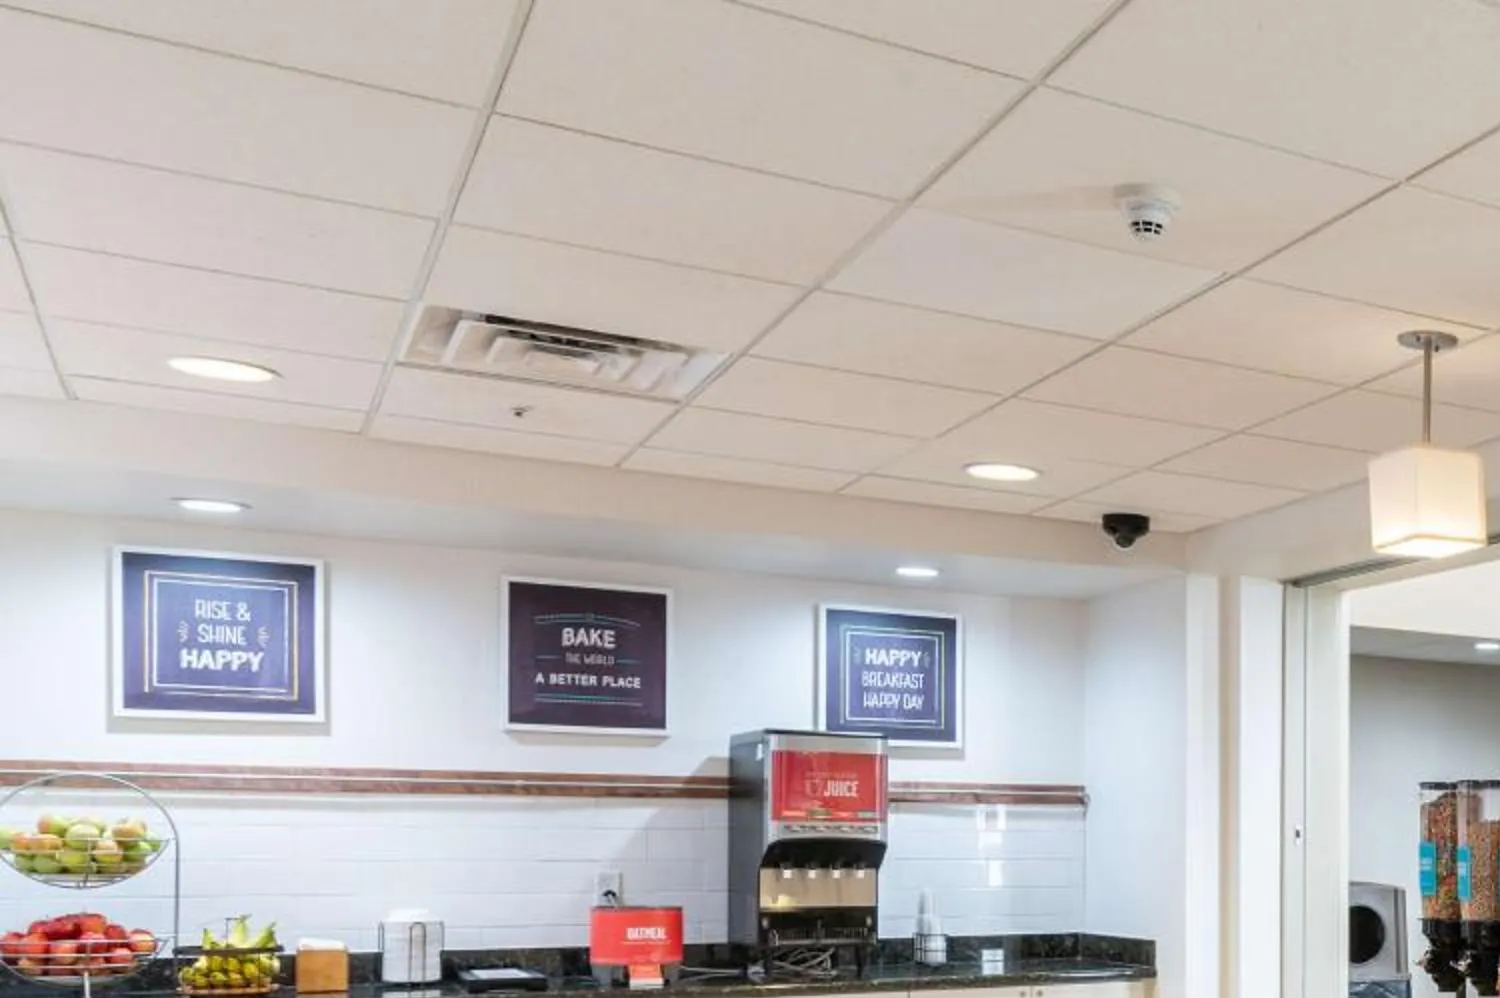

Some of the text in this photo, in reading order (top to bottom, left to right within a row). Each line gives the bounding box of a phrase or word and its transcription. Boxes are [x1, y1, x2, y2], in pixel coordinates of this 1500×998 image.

[195, 599, 251, 621] RISE &
[197, 624, 247, 646] SHINE
[561, 627, 616, 649] BAKE
[179, 648, 264, 673] HAPPY
[864, 648, 922, 668] HAPPY
[535, 672, 641, 689] A BETTER PLACE
[861, 671, 925, 689] BREAKFAST
[863, 691, 925, 711] HAPPY DAY
[823, 779, 859, 797] JUICE
